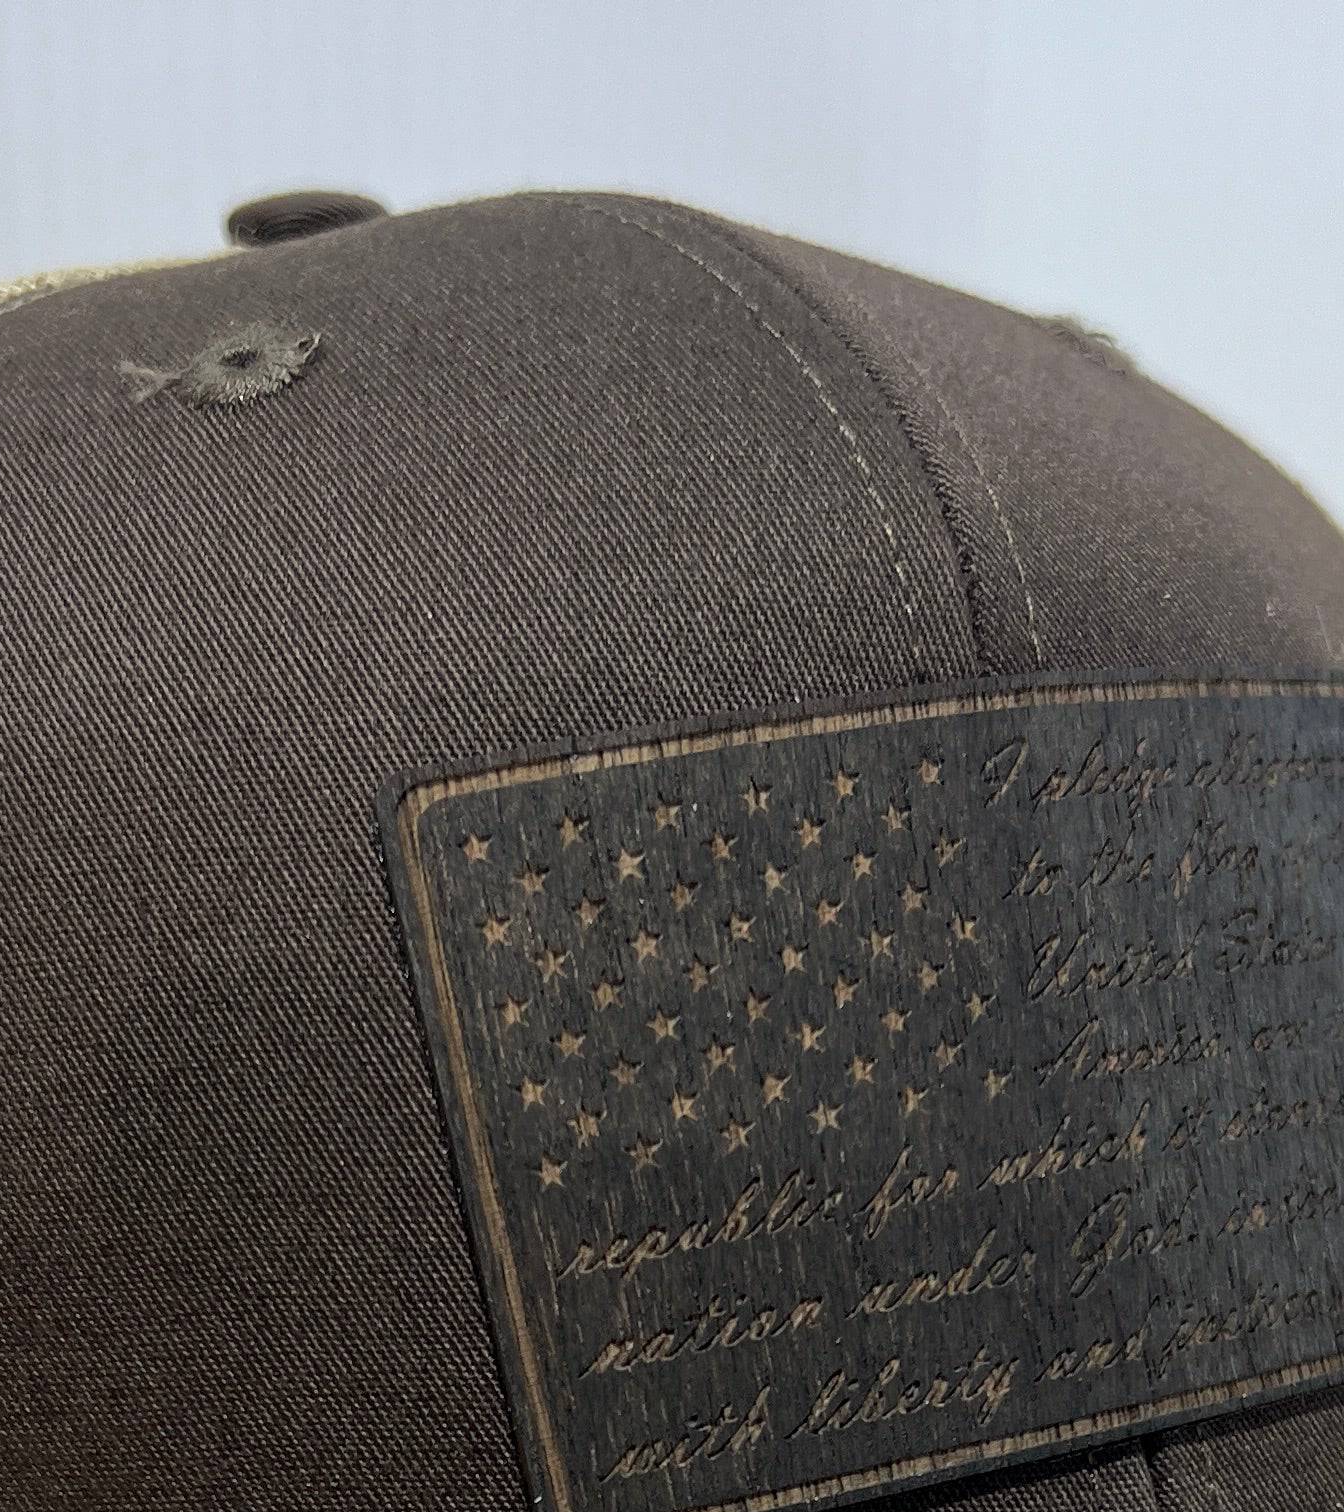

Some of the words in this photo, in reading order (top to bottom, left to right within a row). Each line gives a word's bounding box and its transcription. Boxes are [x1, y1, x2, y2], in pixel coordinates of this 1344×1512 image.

[1032, 733, 1176, 817] pledge
[1001, 845, 1063, 900] to
[1078, 823, 1156, 892] the
[1027, 918, 1207, 1004] United
[554, 1167, 844, 1283] republic
[852, 1142, 962, 1241] for
[977, 1097, 1151, 1193] which
[1161, 1094, 1213, 1153] it
[576, 1291, 828, 1382] nation
[843, 1225, 1039, 1322] under
[597, 1384, 776, 1485] with
[783, 1345, 1023, 1428] liberty
[1034, 1290, 1162, 1385] and
